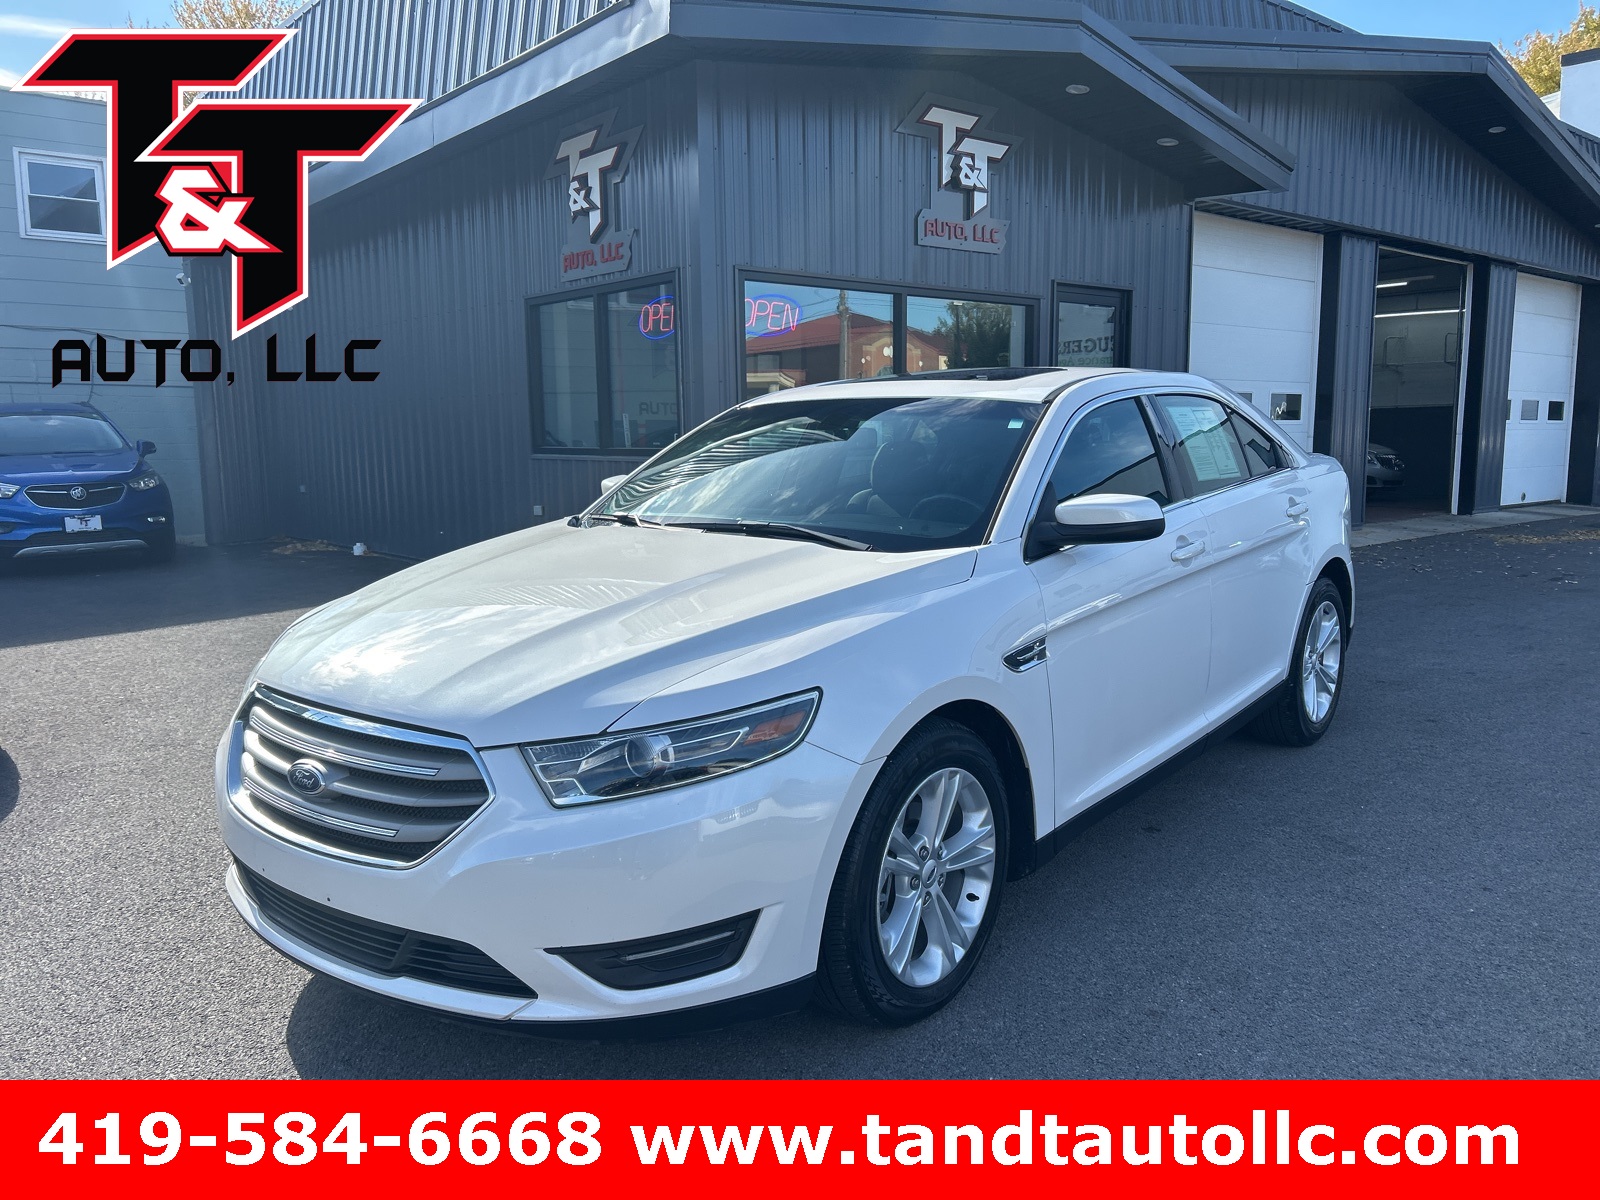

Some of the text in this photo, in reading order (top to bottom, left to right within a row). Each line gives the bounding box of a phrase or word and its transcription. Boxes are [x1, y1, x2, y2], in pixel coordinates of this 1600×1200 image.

[917, 103, 1013, 218] T&T
[555, 129, 619, 240] T&T
[924, 219, 1001, 244] AUTO, LLC
[563, 242, 625, 273] AUTO, LLC
[640, 302, 674, 333] OPE
[745, 298, 799, 331] OPEN
